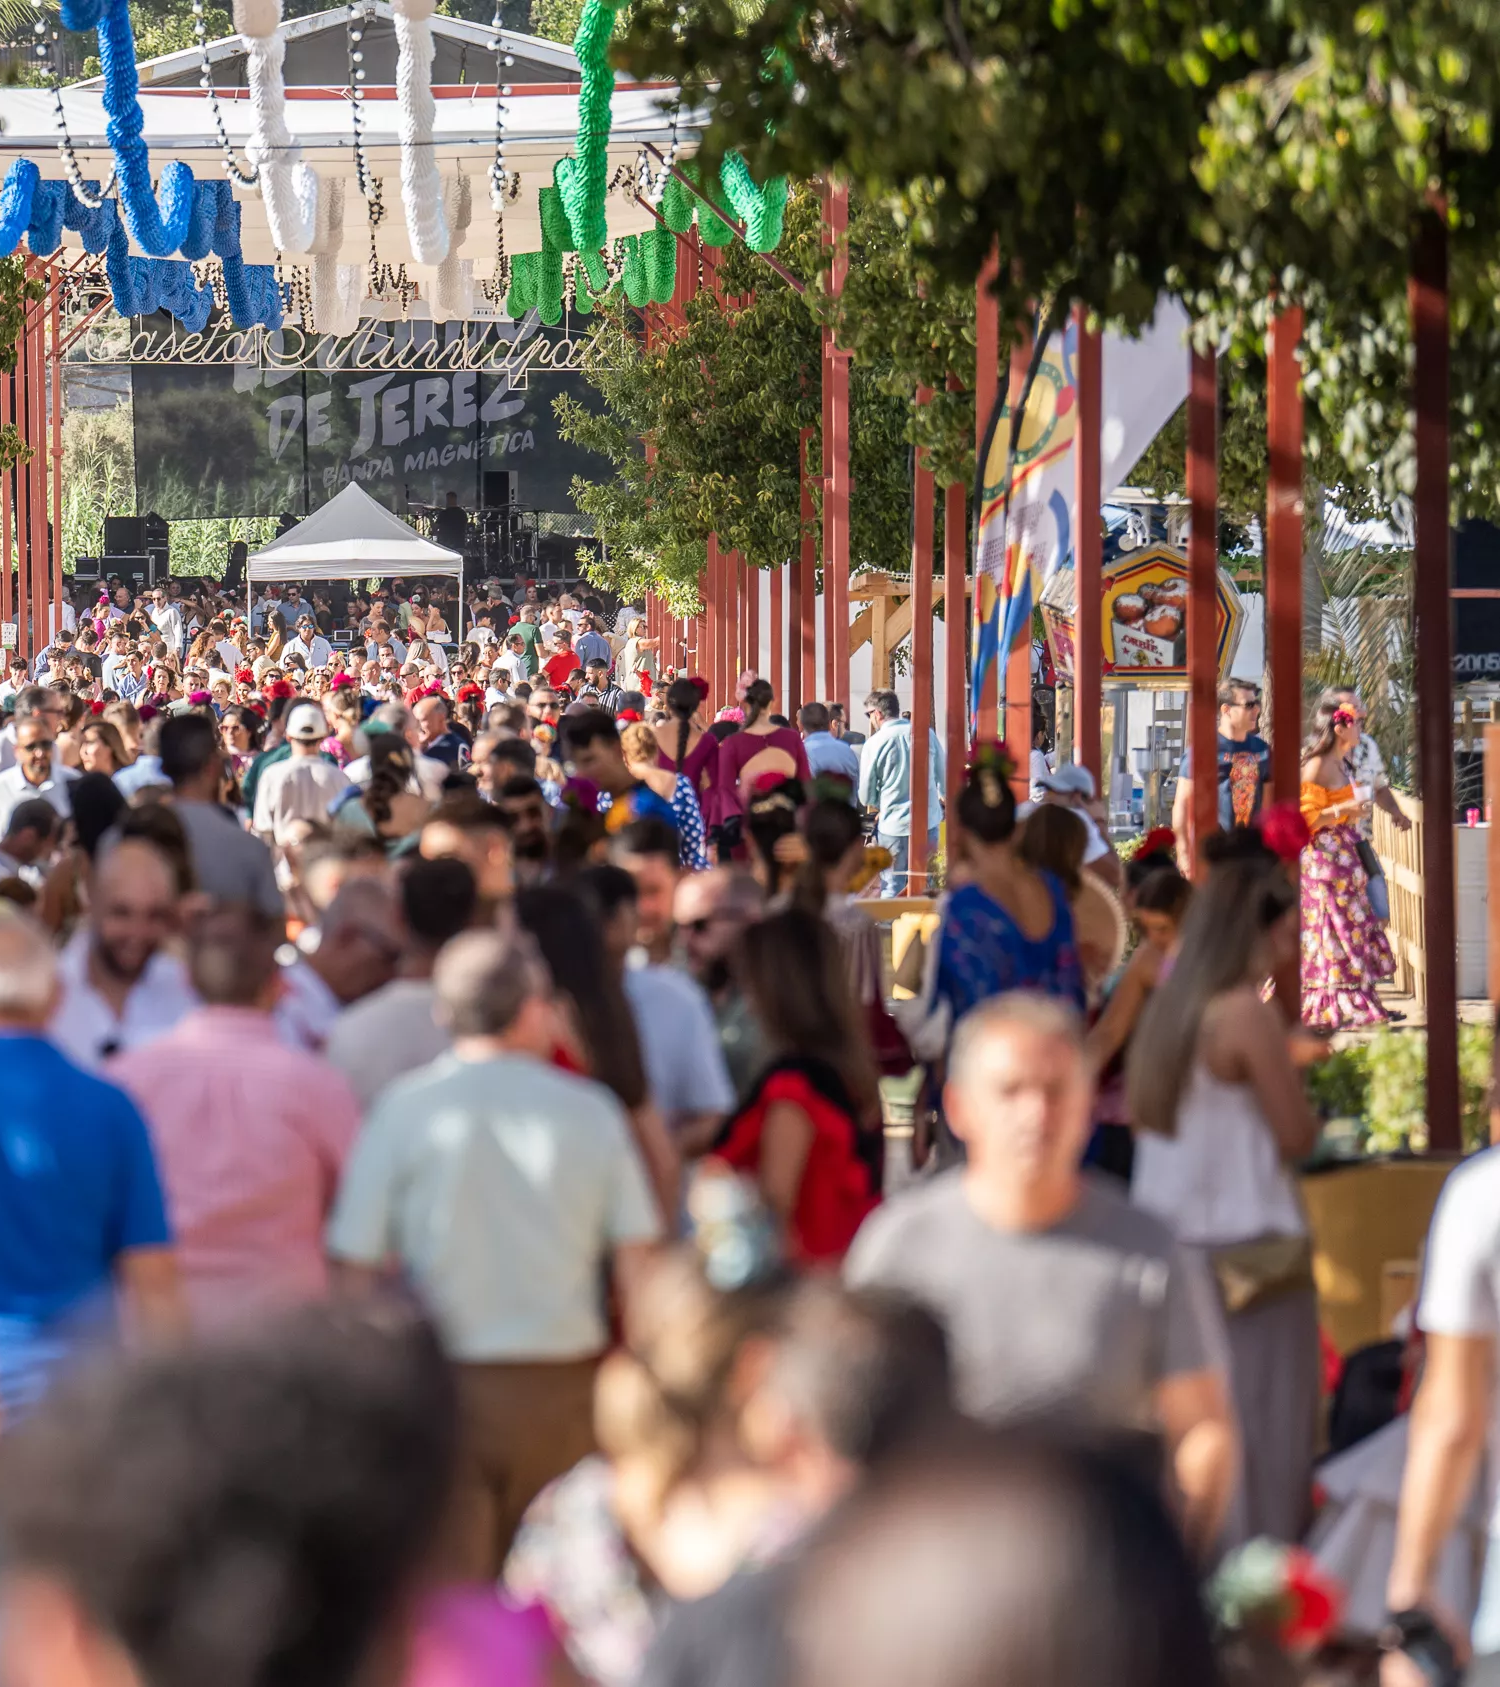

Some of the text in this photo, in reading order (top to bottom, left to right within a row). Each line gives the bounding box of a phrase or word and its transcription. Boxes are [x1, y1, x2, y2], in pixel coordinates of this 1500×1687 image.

[67, 288, 256, 362] Caseta
[265, 357, 526, 464] DE JEREZ
[322, 455, 395, 488] BANDA
[403, 429, 536, 473] MAGNÉTICA
